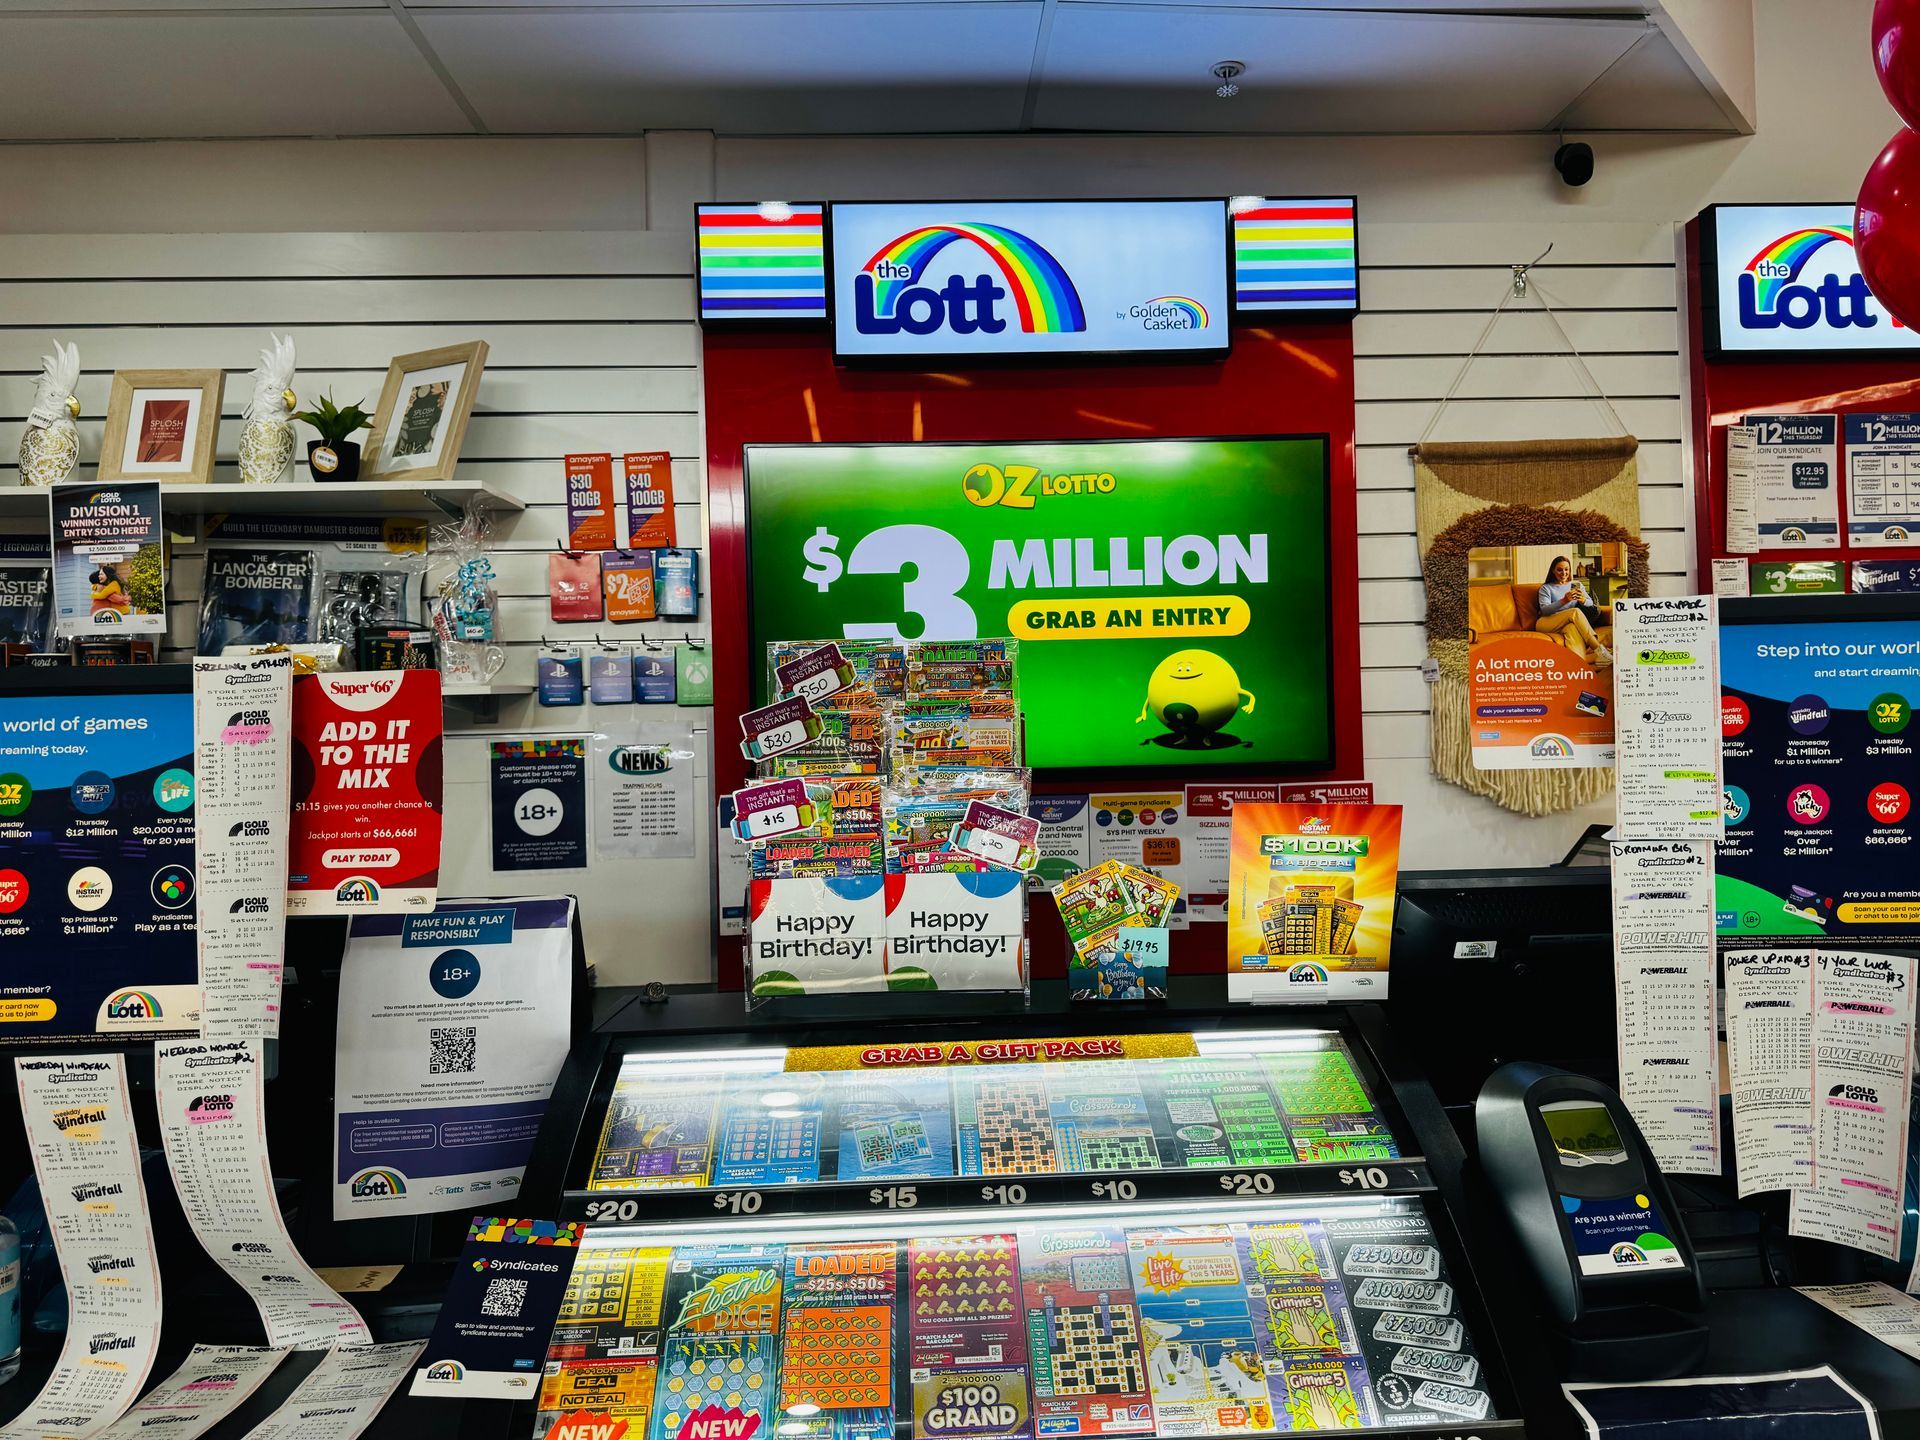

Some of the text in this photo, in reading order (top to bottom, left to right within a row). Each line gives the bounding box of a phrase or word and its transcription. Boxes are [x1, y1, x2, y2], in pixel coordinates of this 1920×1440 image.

[877, 261, 910, 280] the
[1758, 261, 1788, 277] the
[855, 274, 1006, 335] Lott
[1738, 273, 1877, 329] Lott
[1116, 306, 1178, 320] by Golden
[1144, 318, 1188, 330] Casket
[1861, 422, 1886, 442] $12
[570, 456, 605, 464] amaysim
[629, 455, 664, 463] amaysim
[1796, 467, 1824, 475] $12.95
[571, 474, 592, 489] $30
[630, 473, 651, 488] $40
[962, 464, 1116, 509] OZ LOTTO
[572, 491, 601, 507] 60GB
[631, 490, 664, 506] 100GB
[70, 505, 140, 517] DIVISION 1
[61, 517, 151, 528] WINNING SYNDICATE
[223, 523, 379, 535] BUILD THE LEGENDARY DAMBUSTER BOMBER
[64, 527, 148, 537] ENTRY SOLD HERE!
[988, 534, 1268, 589] MILLION
[213, 563, 306, 576] LANCASTER
[226, 577, 292, 589] BOMBER
[607, 573, 629, 599] $2
[1026, 607, 1230, 630] GRAB AN ENTRY
[1639, 614, 1689, 624] Syndicates
[1757, 642, 1875, 659] Step into our
[1476, 658, 1554, 670] A lot more
[225, 674, 271, 685] Syndicates
[1476, 668, 1593, 682] chances to win
[1815, 668, 1868, 677] and start
[330, 681, 369, 695] Super
[799, 679, 827, 697] $50
[3, 716, 148, 734] world of games
[244, 718, 270, 726] LOTTO
[319, 720, 410, 742] ADD IT
[764, 731, 791, 750] $30
[52, 745, 88, 755] today.
[320, 744, 410, 765] TO THE
[1787, 748, 1797, 756] $1
[622, 753, 665, 770] NEWS
[338, 768, 392, 789] MIX
[1235, 791, 1274, 799] MILLION
[1327, 788, 1368, 797] MILLION
[296, 803, 319, 811] $1.15
[323, 802, 343, 812] gives
[345, 803, 360, 811] you
[362, 801, 392, 809] another
[395, 801, 422, 809] chance
[520, 805, 557, 821] 18+
[355, 815, 371, 823] win.
[763, 812, 784, 826] $15
[66, 828, 117, 837] $12 Million
[308, 829, 416, 840] Jackpot starts at $66,666!
[1147, 841, 1175, 849] $36.18
[331, 854, 391, 863] PLAY TODAY
[766, 848, 814, 860] LOADED
[824, 846, 871, 859] LOADED
[412, 915, 505, 927] HAVE FUN & PLAY
[777, 915, 855, 935] Happy
[64, 926, 75, 934] $1
[411, 929, 480, 940] RESPONSIBLY
[1621, 932, 1707, 945] POWERHIT
[760, 937, 872, 959] Birthday!
[1122, 939, 1158, 953] $19.95
[442, 968, 471, 981] 18+
[4, 986, 51, 994] member?
[861, 1039, 1123, 1065] GRAB A GIFT PACK
[204, 1095, 230, 1103] GOLD
[204, 1102, 233, 1110] LOTTO
[53, 1110, 106, 1130] Windfall
[1220, 1173, 1274, 1195] $20
[870, 1187, 918, 1208] $15
[981, 1185, 1026, 1204] $10
[714, 1192, 761, 1213] $10
[586, 1200, 638, 1221] $20
[1592, 1216, 1607, 1224] you
[1617, 1211, 1651, 1220] winner?
[1327, 1219, 1425, 1230] GOLD STANDARD
[1040, 1235, 1111, 1253] Crosswords
[1352, 1248, 1424, 1264] $250,000
[490, 1260, 559, 1272] Syndicates
[1147, 1258, 1172, 1273] Live
[1161, 1268, 1182, 1286] Life
[809, 1278, 885, 1291] $25s $50s
[1366, 1283, 1435, 1299] $100,000
[669, 1270, 776, 1330] Electric
[1271, 1294, 1323, 1309] Gimme 5
[715, 1305, 772, 1328] DICE
[576, 1377, 617, 1387] DEAL
[1335, 1374, 1343, 1386] 5
[563, 1395, 622, 1404] NO DEAL
[942, 1387, 998, 1405] $100
[1423, 1385, 1477, 1405] $25,000
[929, 1405, 1016, 1427] GRAND
[691, 1420, 747, 1438] NEW
